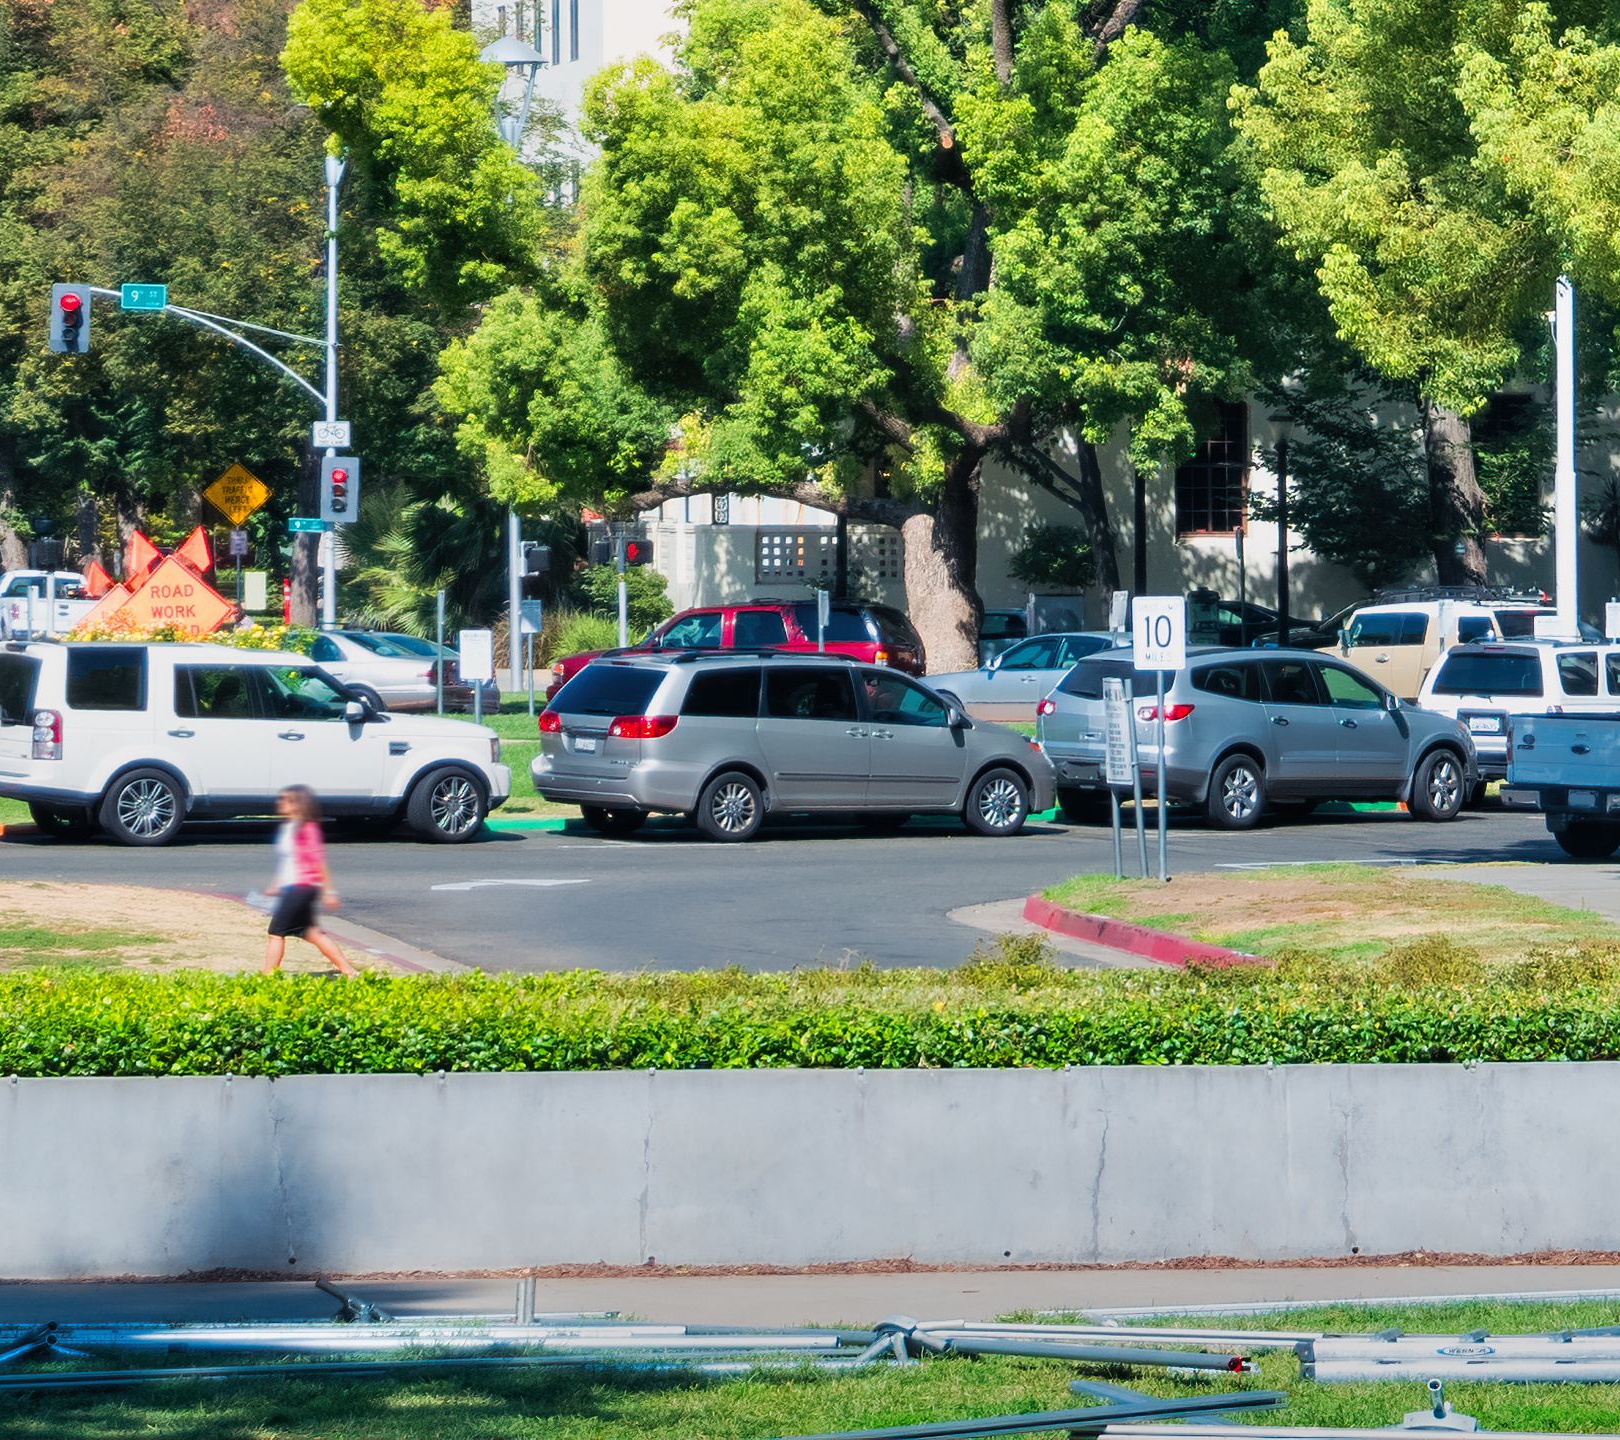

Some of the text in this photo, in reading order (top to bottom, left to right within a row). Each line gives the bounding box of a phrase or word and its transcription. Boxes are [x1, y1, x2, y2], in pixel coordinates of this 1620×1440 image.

[224, 495, 250, 505] MERGE
[150, 584, 195, 599] ROAD
[151, 604, 196, 619] WORK
[1143, 614, 1172, 648] 10
